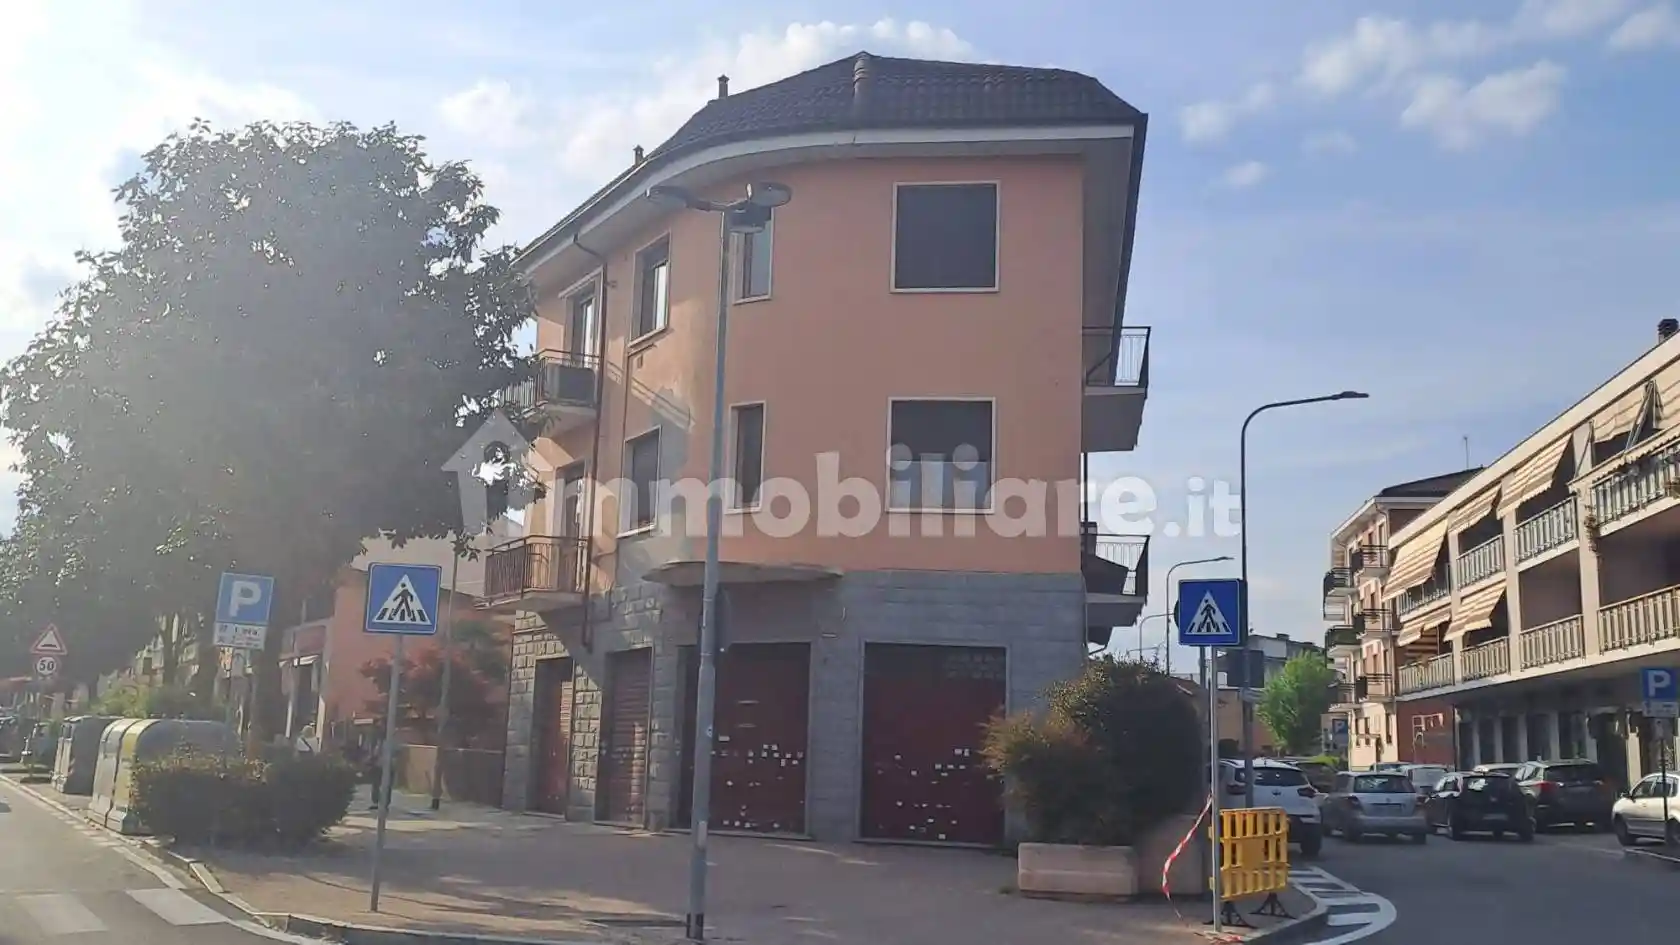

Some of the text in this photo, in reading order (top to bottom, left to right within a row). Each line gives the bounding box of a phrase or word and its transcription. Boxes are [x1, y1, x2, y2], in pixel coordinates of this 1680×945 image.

[229, 581, 262, 617] P
[39, 659, 55, 671] 50
[1648, 670, 1671, 697] P
